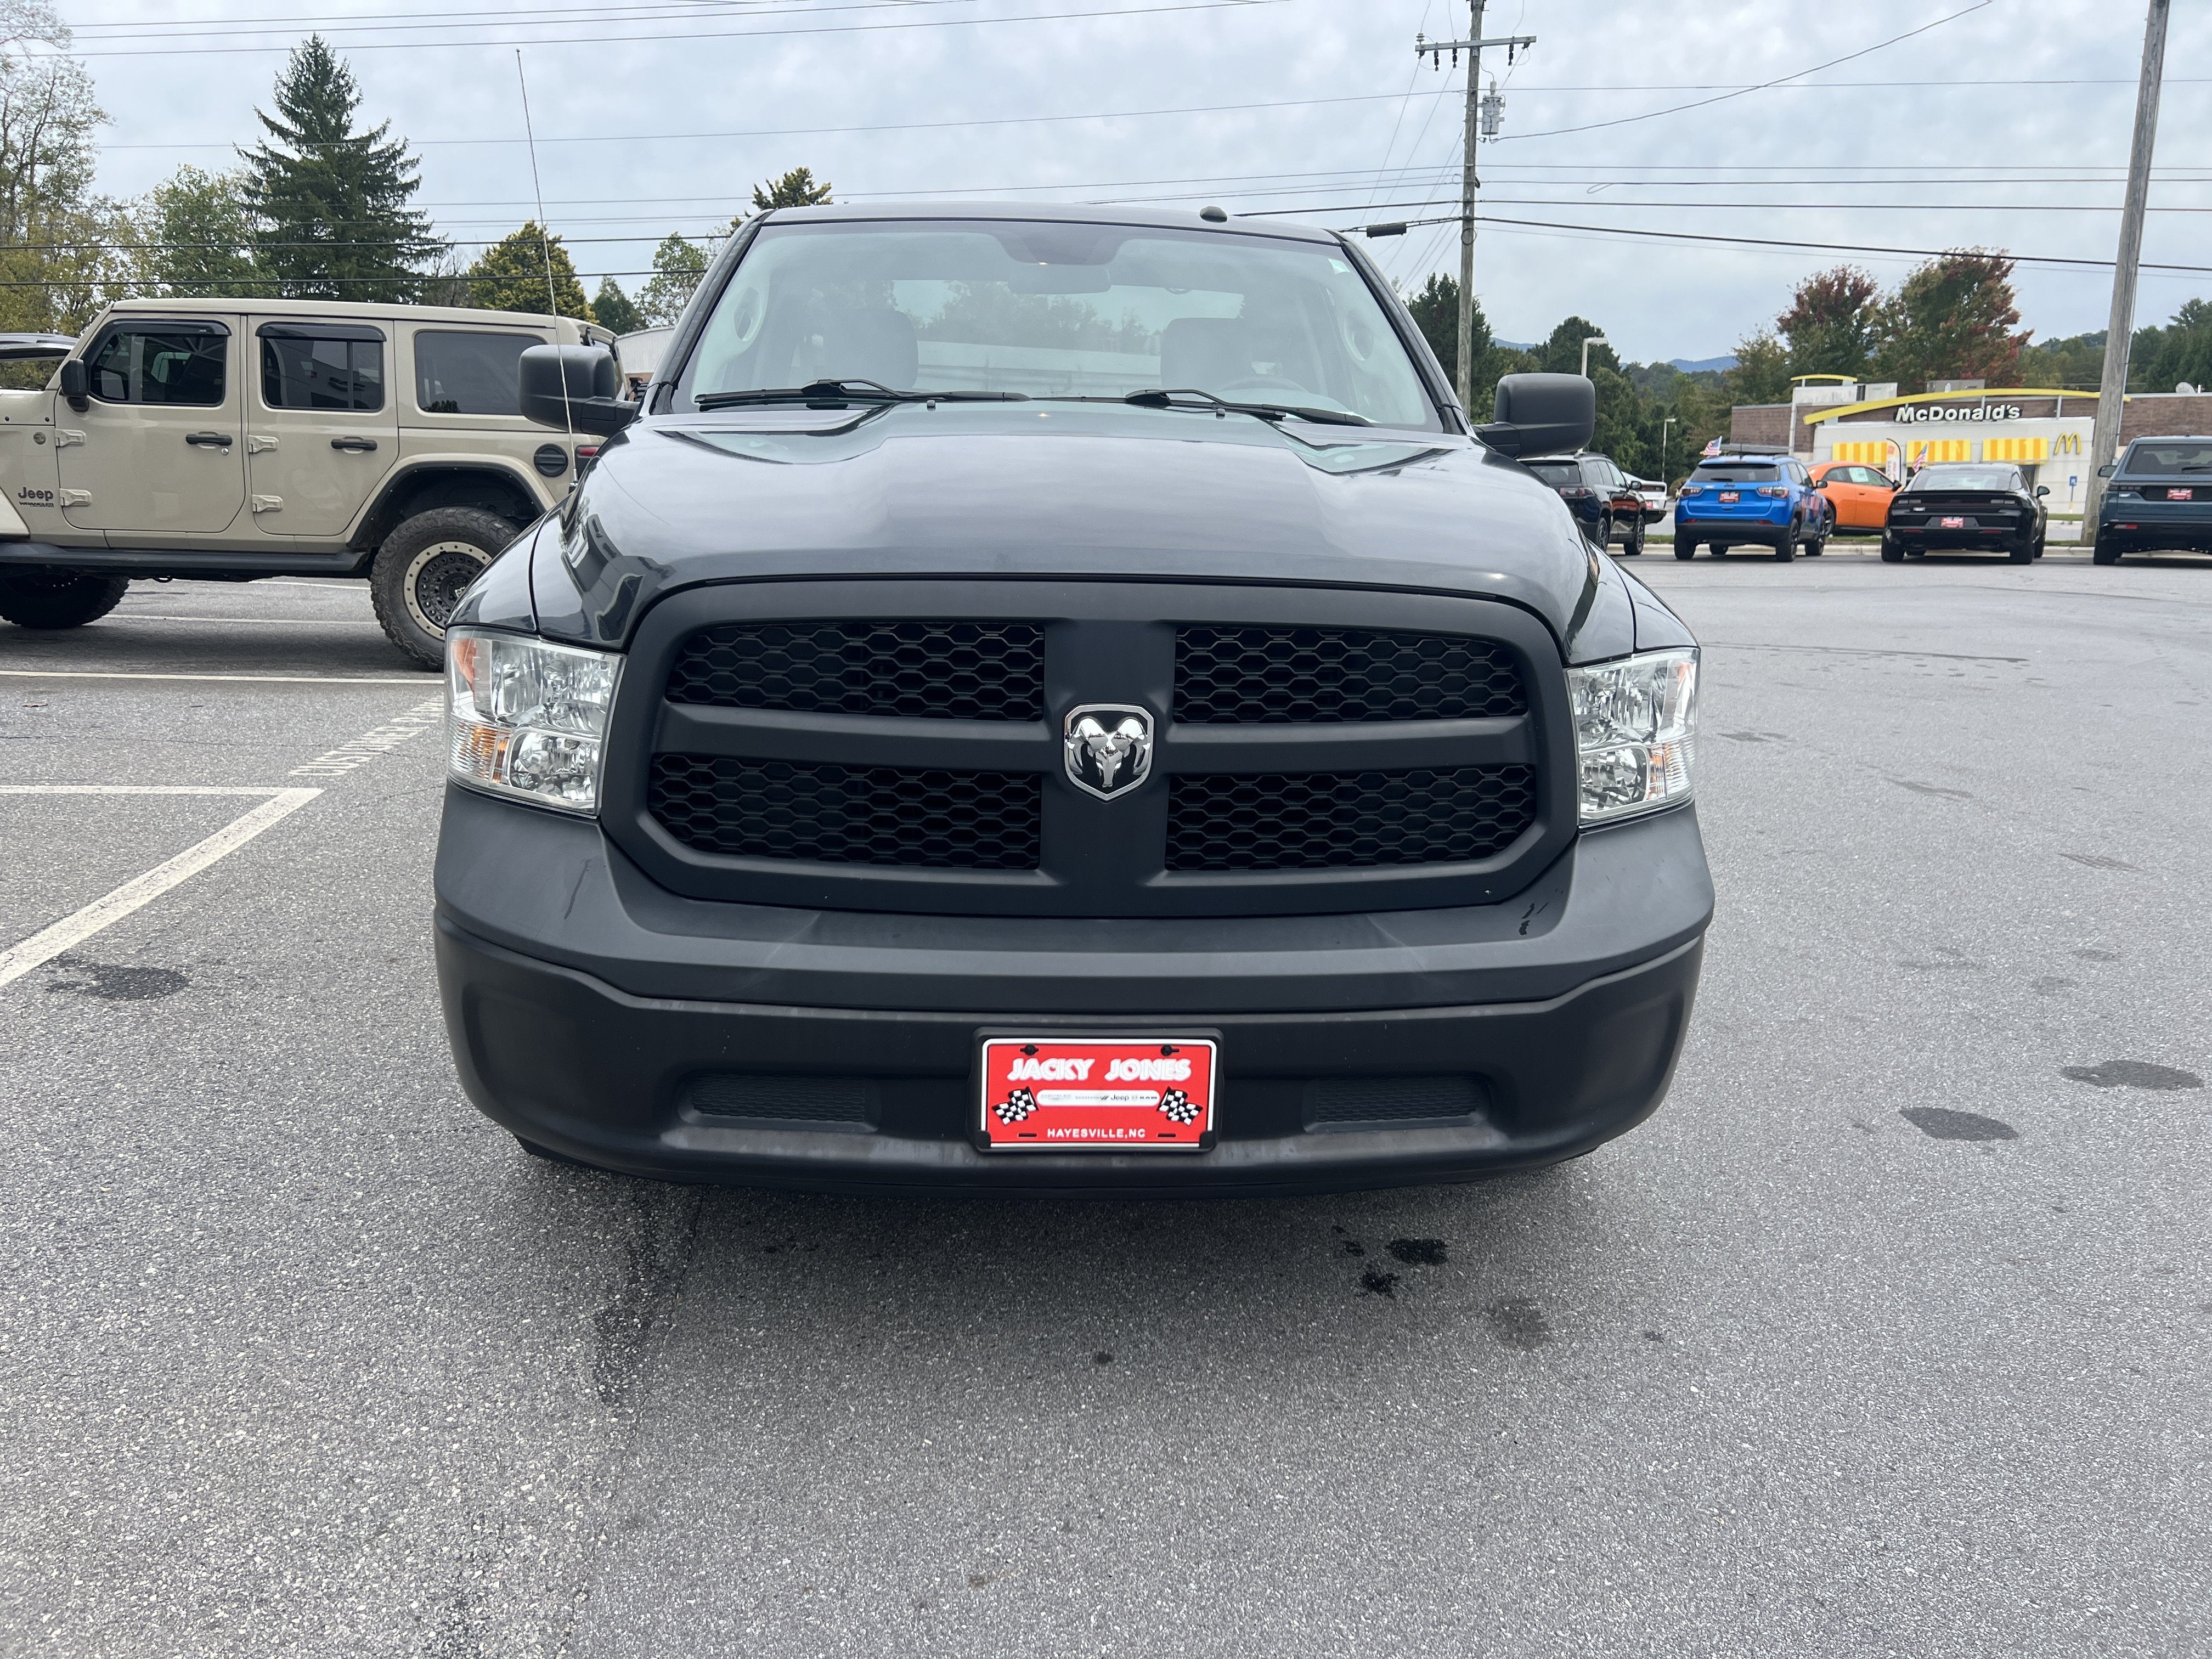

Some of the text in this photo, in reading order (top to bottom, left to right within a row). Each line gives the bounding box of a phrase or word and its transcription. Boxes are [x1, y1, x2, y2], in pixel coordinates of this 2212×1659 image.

[1895, 404, 2021, 422] McDonald's
[18, 487, 53, 501] Jeep
[1007, 1058, 1191, 1081] JACKY JONES
[1047, 1128, 1146, 1138] HAYESVILLE,NC
